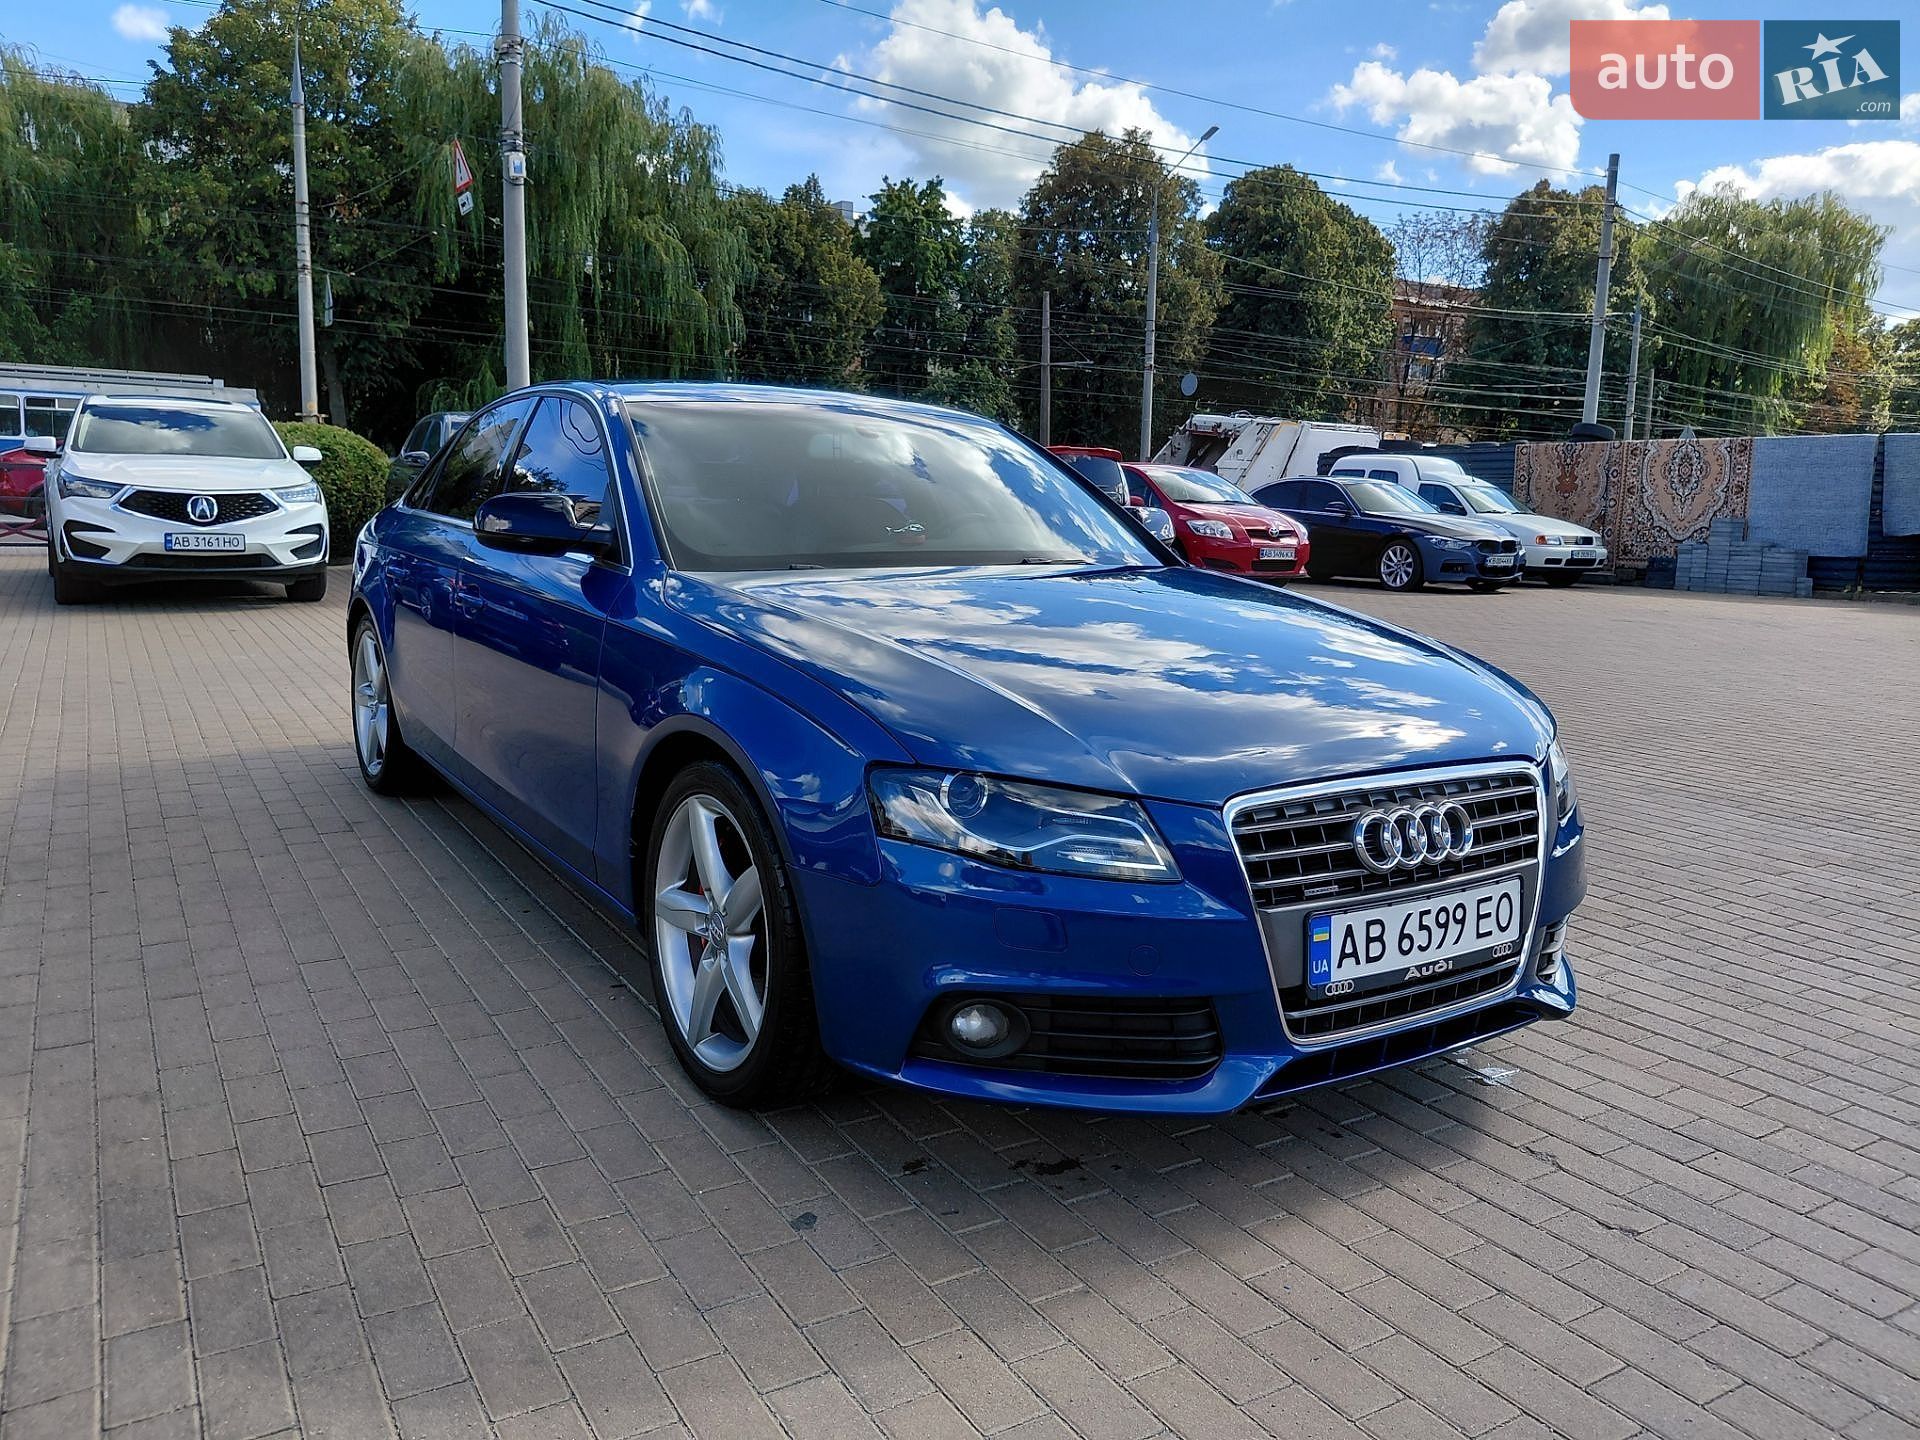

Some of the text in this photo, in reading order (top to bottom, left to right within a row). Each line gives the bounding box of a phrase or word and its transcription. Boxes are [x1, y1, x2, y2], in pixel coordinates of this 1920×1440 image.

[173, 536, 240, 548] AB 3161 HO
[1337, 892, 1514, 969] AB 6599 EO
[1313, 961, 1329, 974] UA
[1404, 960, 1453, 981] Audi
